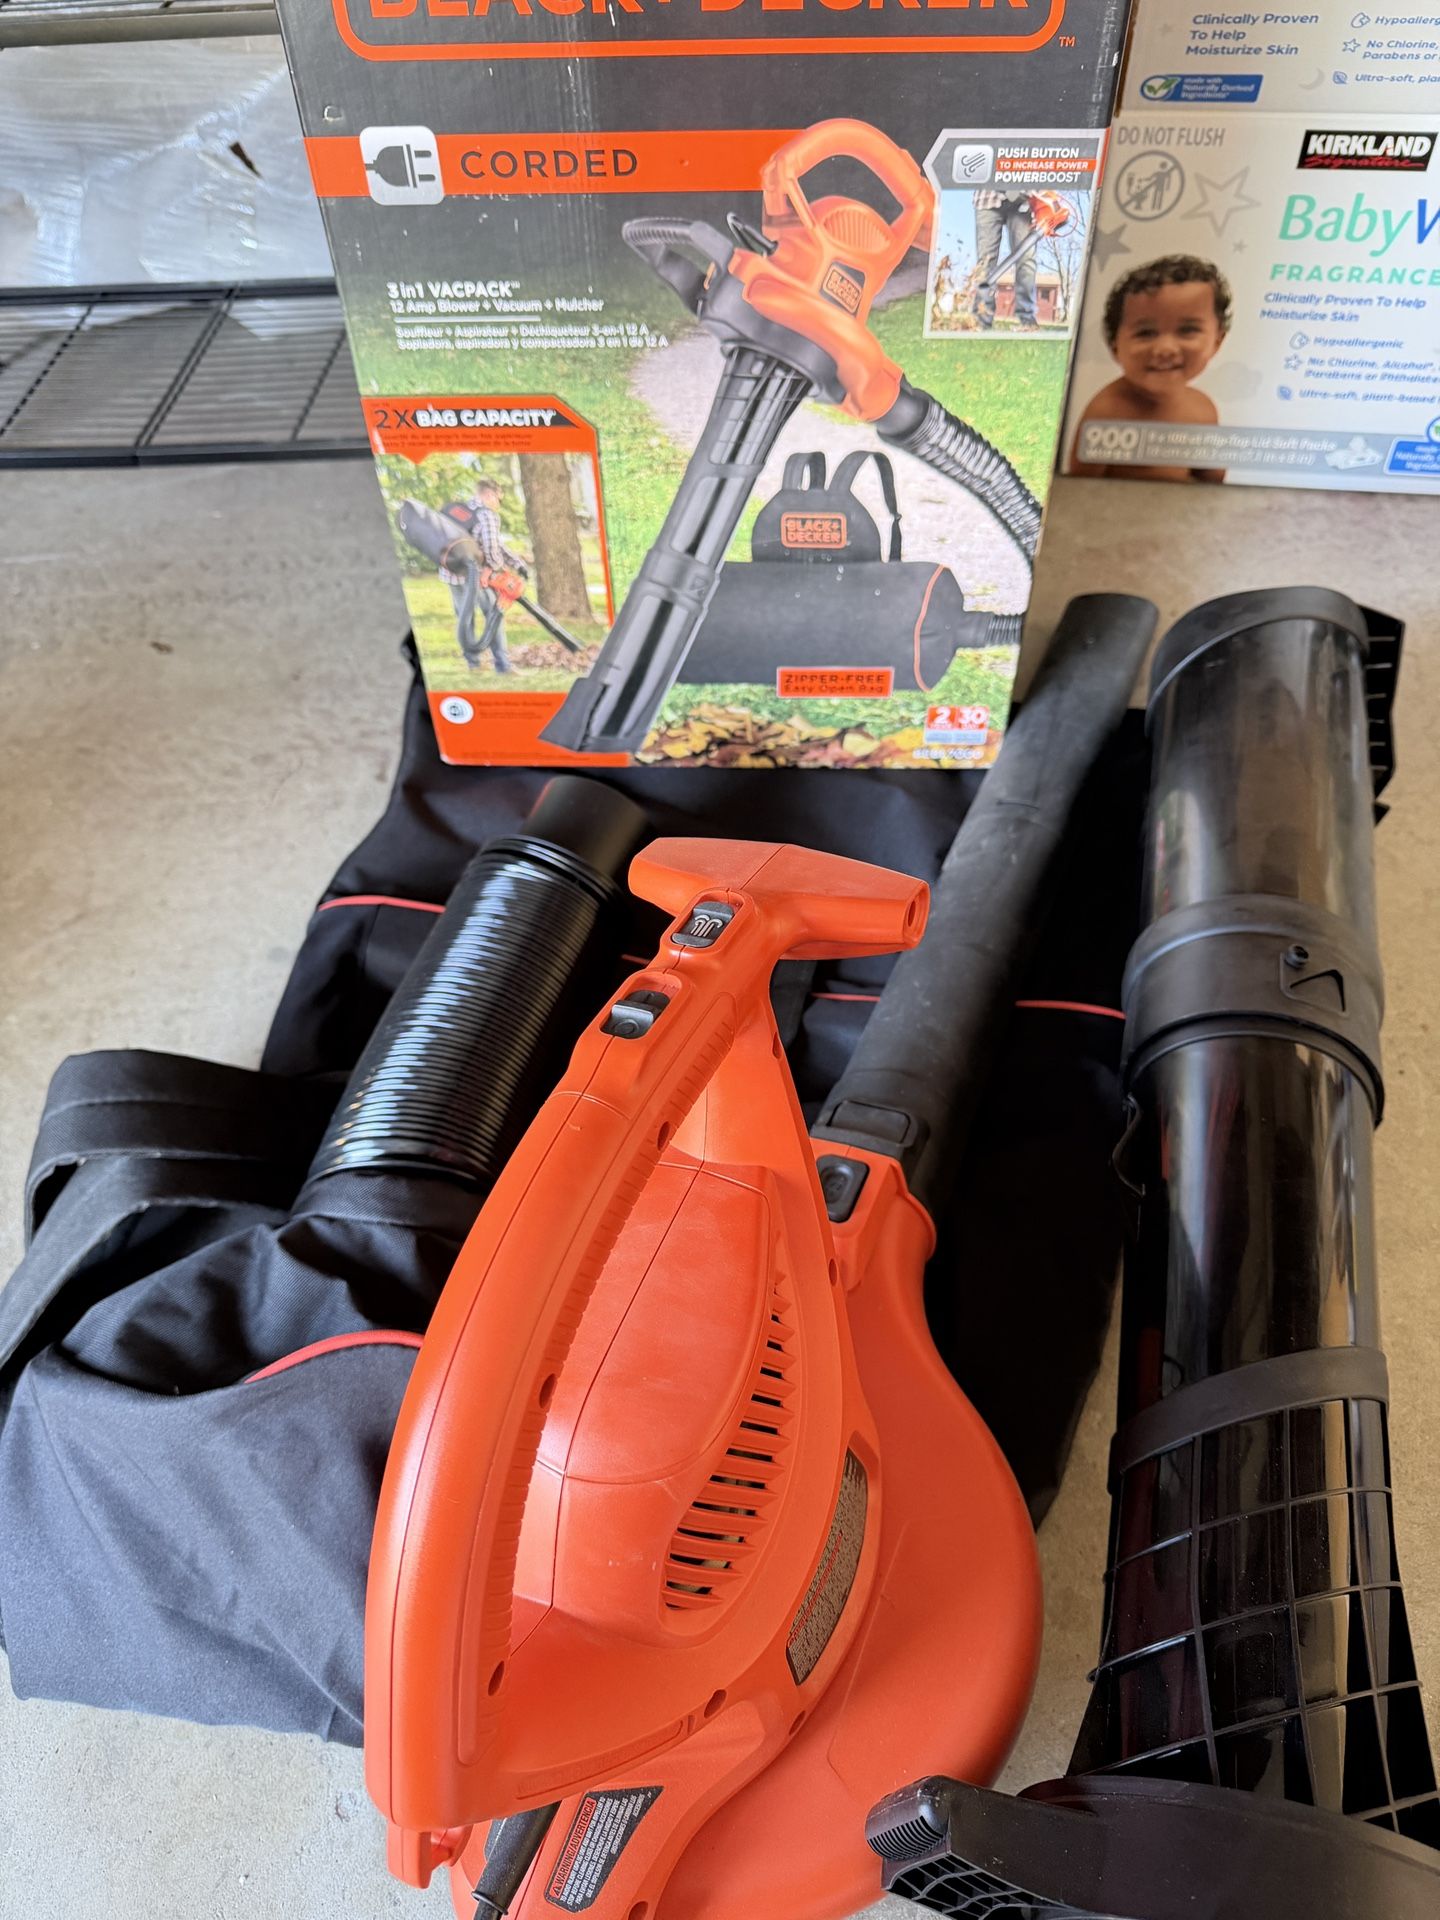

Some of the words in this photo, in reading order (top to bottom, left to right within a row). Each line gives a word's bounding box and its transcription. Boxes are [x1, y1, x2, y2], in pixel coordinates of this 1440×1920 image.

[1192, 13, 1259, 25] Clinically
[1263, 13, 1319, 24] Proven
[1190, 29, 1208, 40] To
[1212, 29, 1246, 42] Help
[1185, 44, 1263, 56] Moisturize
[1266, 44, 1299, 56] Skin
[1367, 40, 1383, 48] No
[1387, 40, 1439, 50] Chlorine,
[1363, 51, 1420, 60] Parabens
[1117, 126, 1140, 145] DO
[1143, 127, 1175, 146] NOT
[1176, 127, 1227, 147] FLUSH
[1307, 134, 1432, 157] KIRKLAND
[998, 148, 1028, 158] PUSH
[1031, 148, 1079, 158] BUTTON
[460, 149, 638, 179] CORDED
[1000, 161, 1011, 169] TO
[1013, 161, 1056, 169] INCREASE
[1056, 161, 1088, 169] POWER
[995, 172, 1080, 183] POWERBOOST
[390, 301, 404, 313] 12
[406, 300, 435, 314] Amp
[437, 299, 480, 312] Blower
[493, 298, 542, 312] Vacuum
[555, 298, 604, 311] Mulcher
[1264, 293, 1320, 306] Clinically
[1324, 294, 1373, 306] Proven
[1377, 297, 1392, 308] To
[1395, 297, 1427, 310] Help
[1330, 311, 1360, 322] Skin
[416, 409, 458, 428] BAG
[1086, 427, 1139, 450] 900
[787, 532, 841, 544] DECKER
[785, 674, 885, 684] ZIPPER-FREE
[554, 1800, 595, 1885] WARNING/ADVERTENCIA
